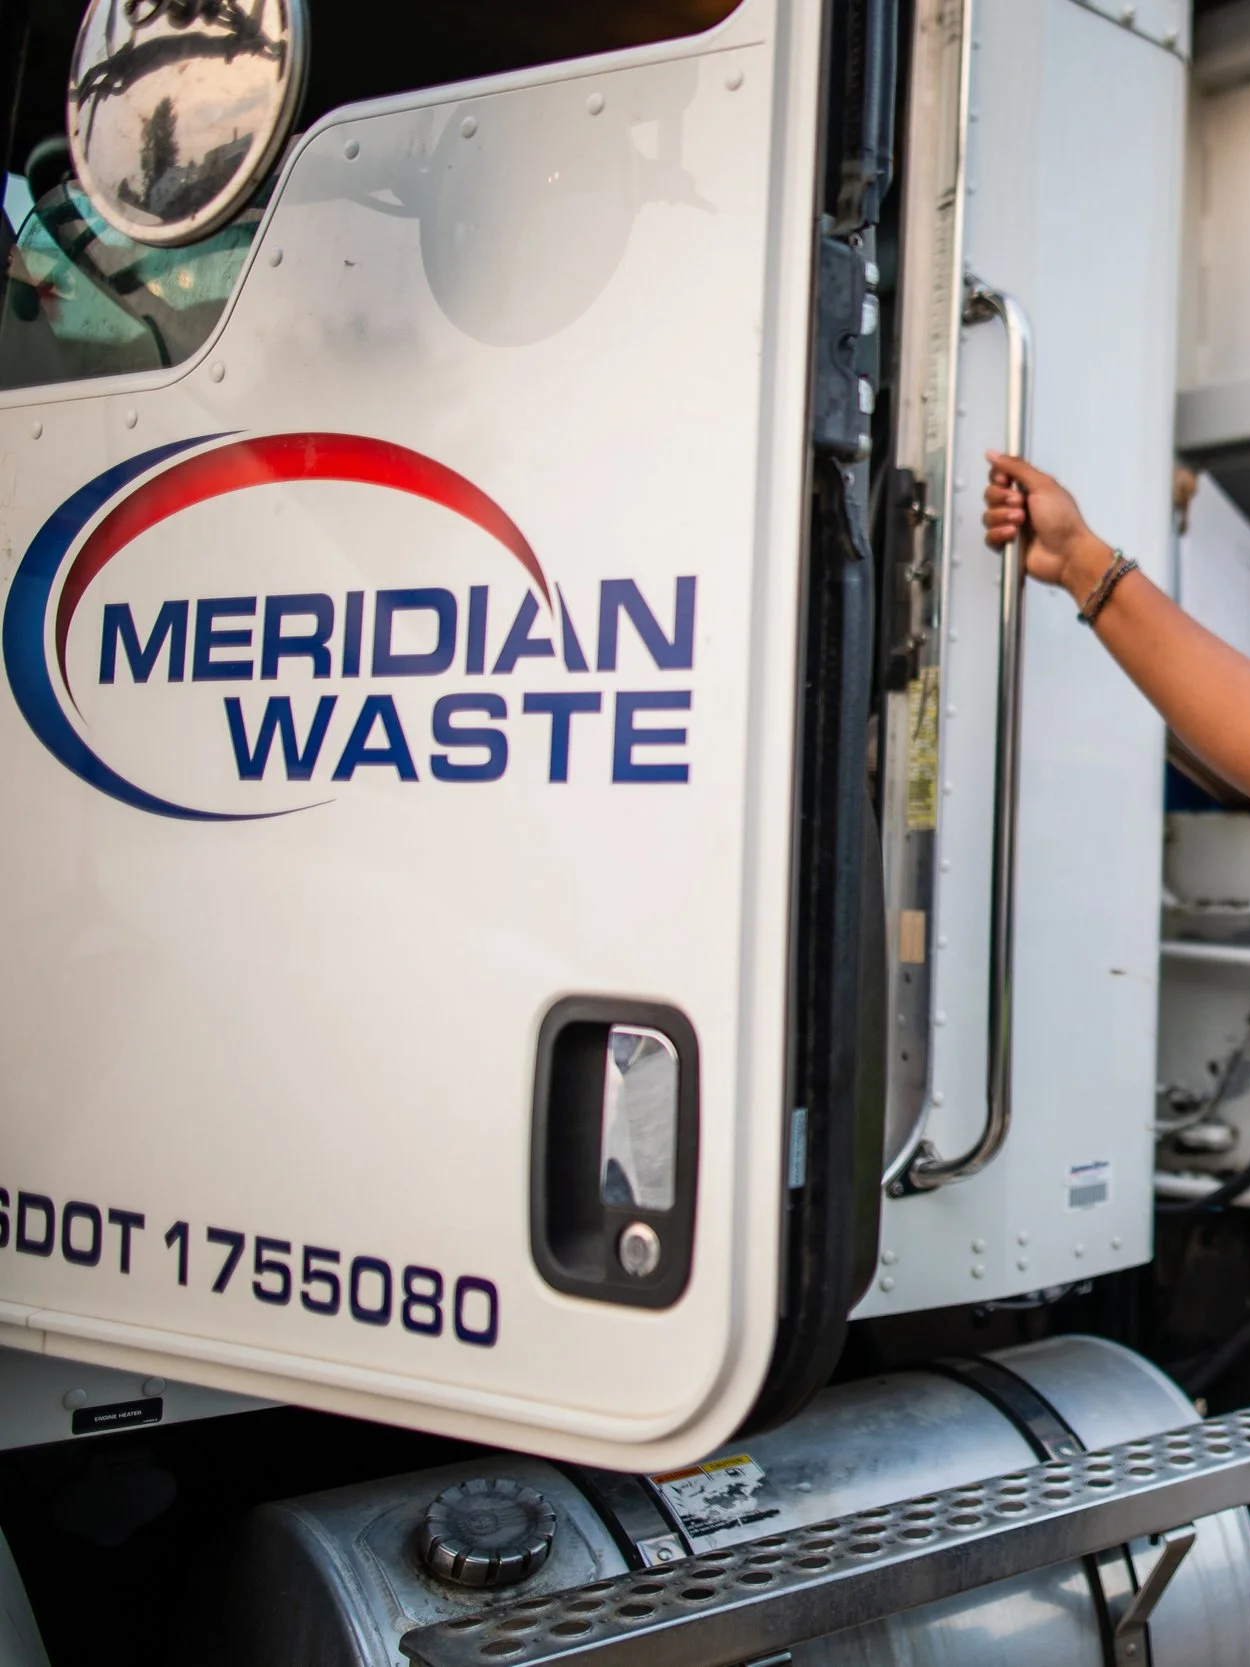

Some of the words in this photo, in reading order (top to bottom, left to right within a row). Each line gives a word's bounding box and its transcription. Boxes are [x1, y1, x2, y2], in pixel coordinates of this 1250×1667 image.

[98, 575, 697, 684] MERIDIAN
[223, 690, 693, 784] WASTE
[0, 1187, 145, 1276] DOT
[164, 1220, 500, 1348] 1755080
[94, 1413, 118, 1422] ENGINE
[118, 1410, 142, 1419] HEATER
